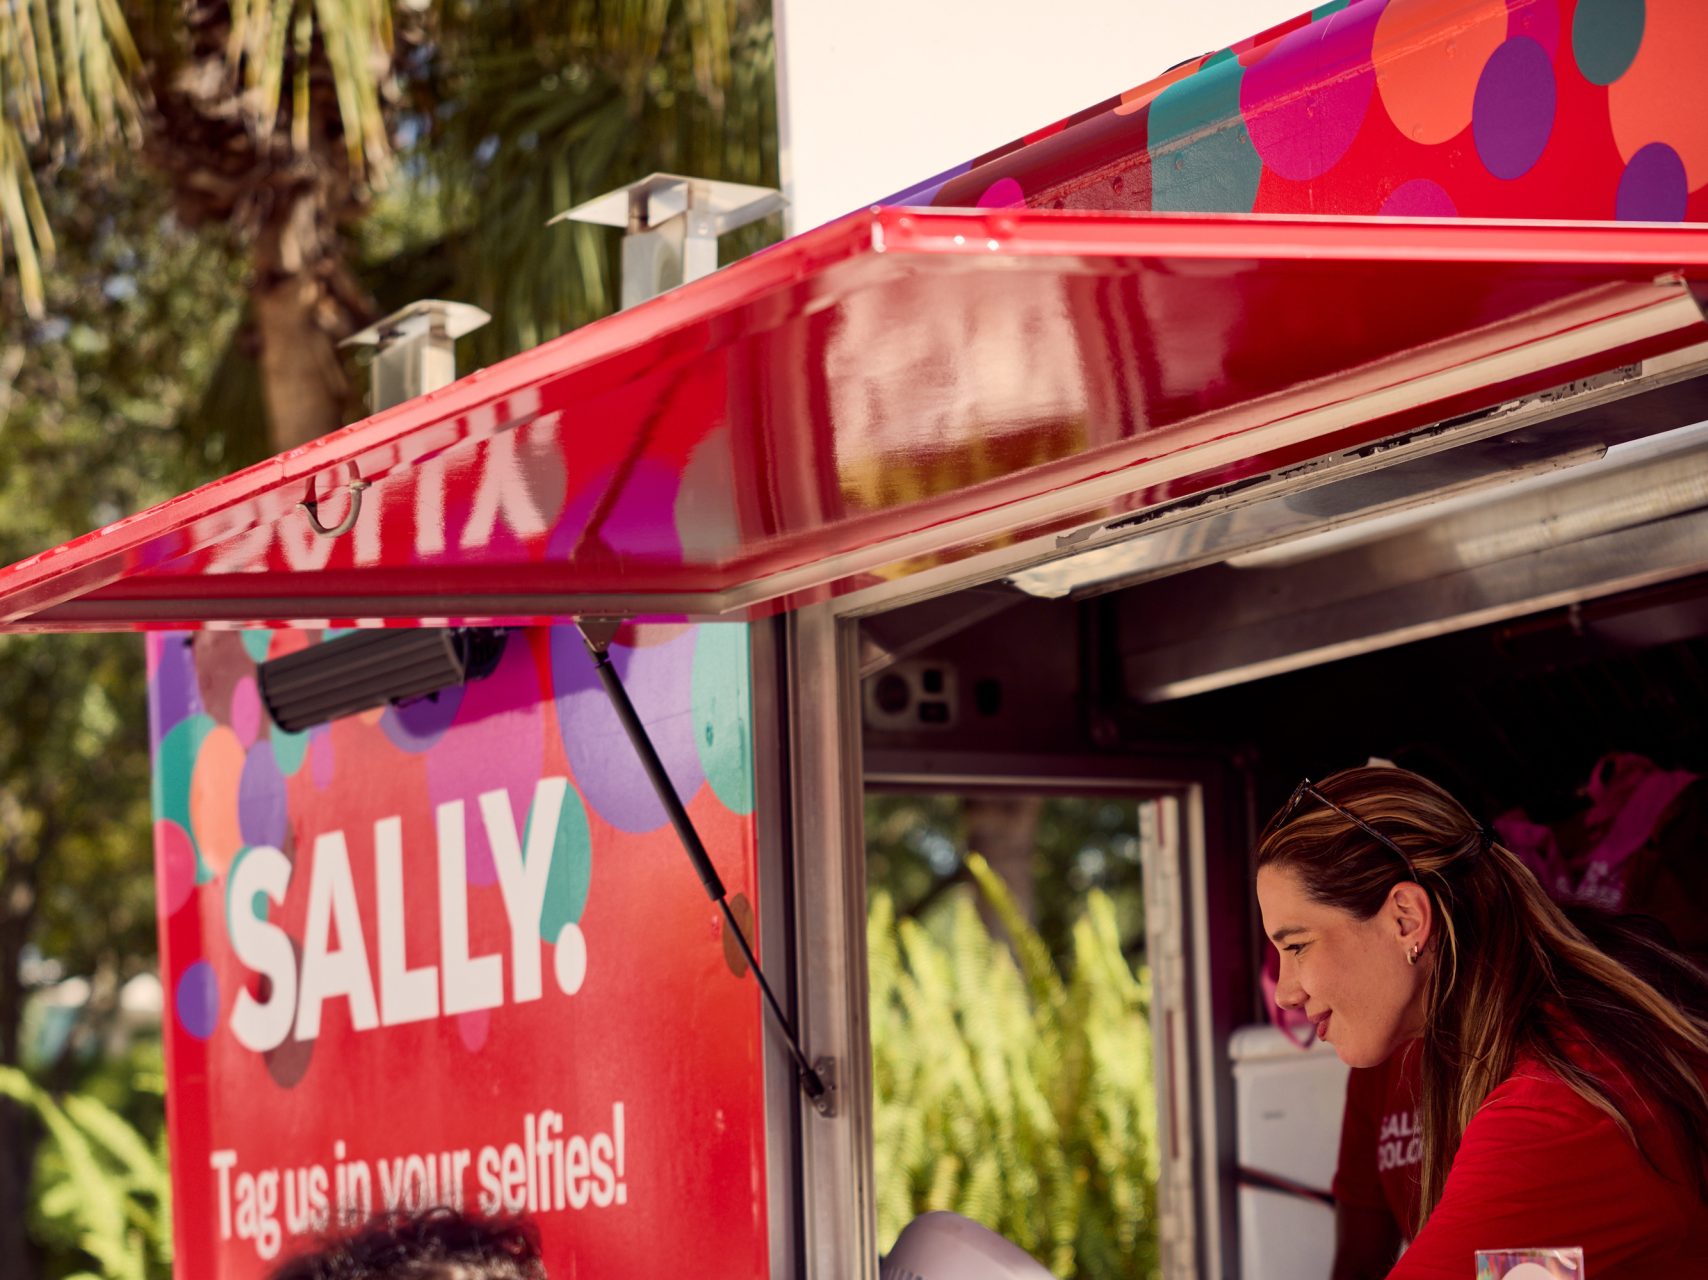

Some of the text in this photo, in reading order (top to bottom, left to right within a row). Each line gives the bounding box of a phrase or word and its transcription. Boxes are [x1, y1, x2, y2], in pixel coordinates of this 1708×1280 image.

[229, 776, 588, 1053] SALLY.
[209, 1101, 628, 1260] Tag us in your selfies!
